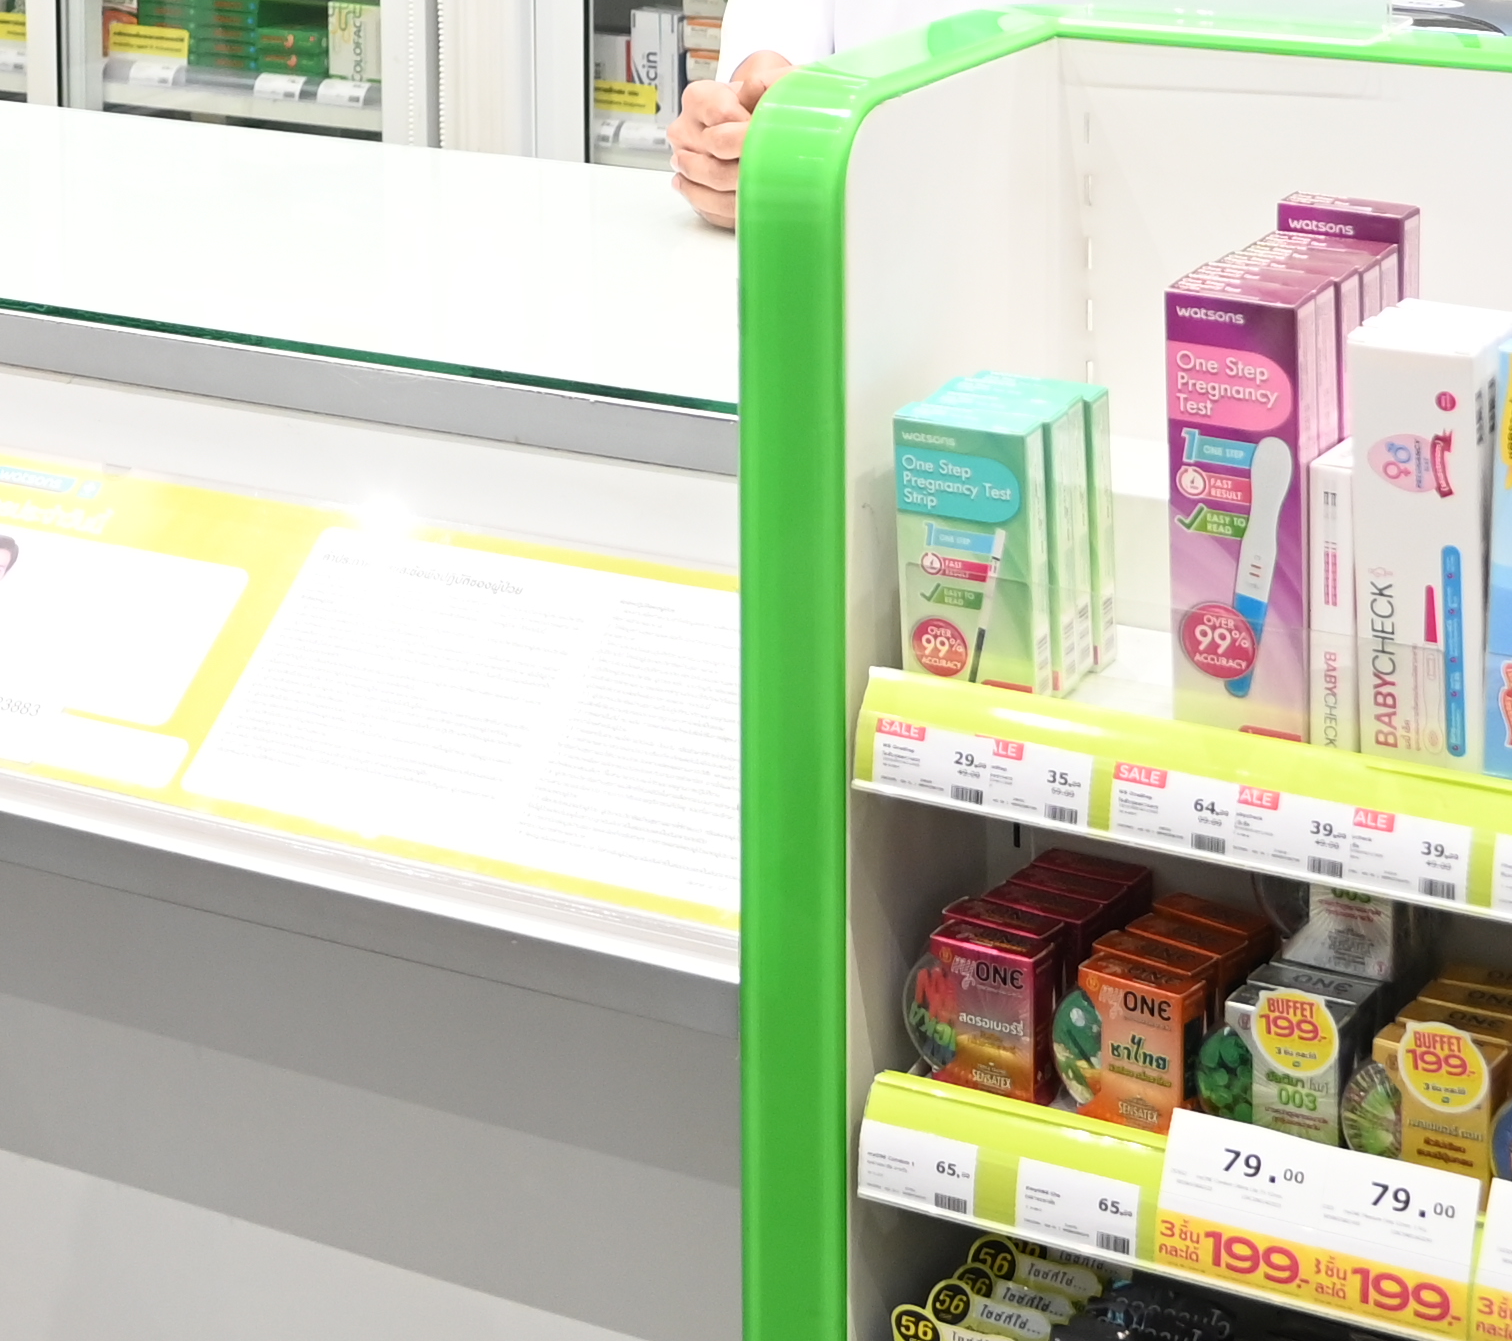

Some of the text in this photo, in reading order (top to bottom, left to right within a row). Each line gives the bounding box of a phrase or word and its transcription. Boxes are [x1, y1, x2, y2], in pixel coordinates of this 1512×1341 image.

[1288, 217, 1355, 236] watsons
[1175, 305, 1245, 325] watsons
[1175, 349, 1269, 383] One Step
[1176, 371, 1278, 410] Pregnancy
[1175, 393, 1213, 417] Test
[1209, 477, 1234, 491] FAST
[1209, 487, 1243, 502] RESULT
[1205, 511, 1231, 526] EASY
[1205, 521, 1234, 536] READ
[1203, 614, 1235, 630] OVER
[1194, 623, 1251, 656] 99%
[1193, 651, 1248, 672] ACCURACY
[1369, 580, 1400, 750] BABYCHECK
[1118, 763, 1161, 786] SALE
[1266, 997, 1316, 1020] BUFFET
[1109, 1033, 1169, 1072] ชาไทย
[1278, 1087, 1319, 1112] 003
[1159, 1218, 1201, 1246] 3 ชิ้น
